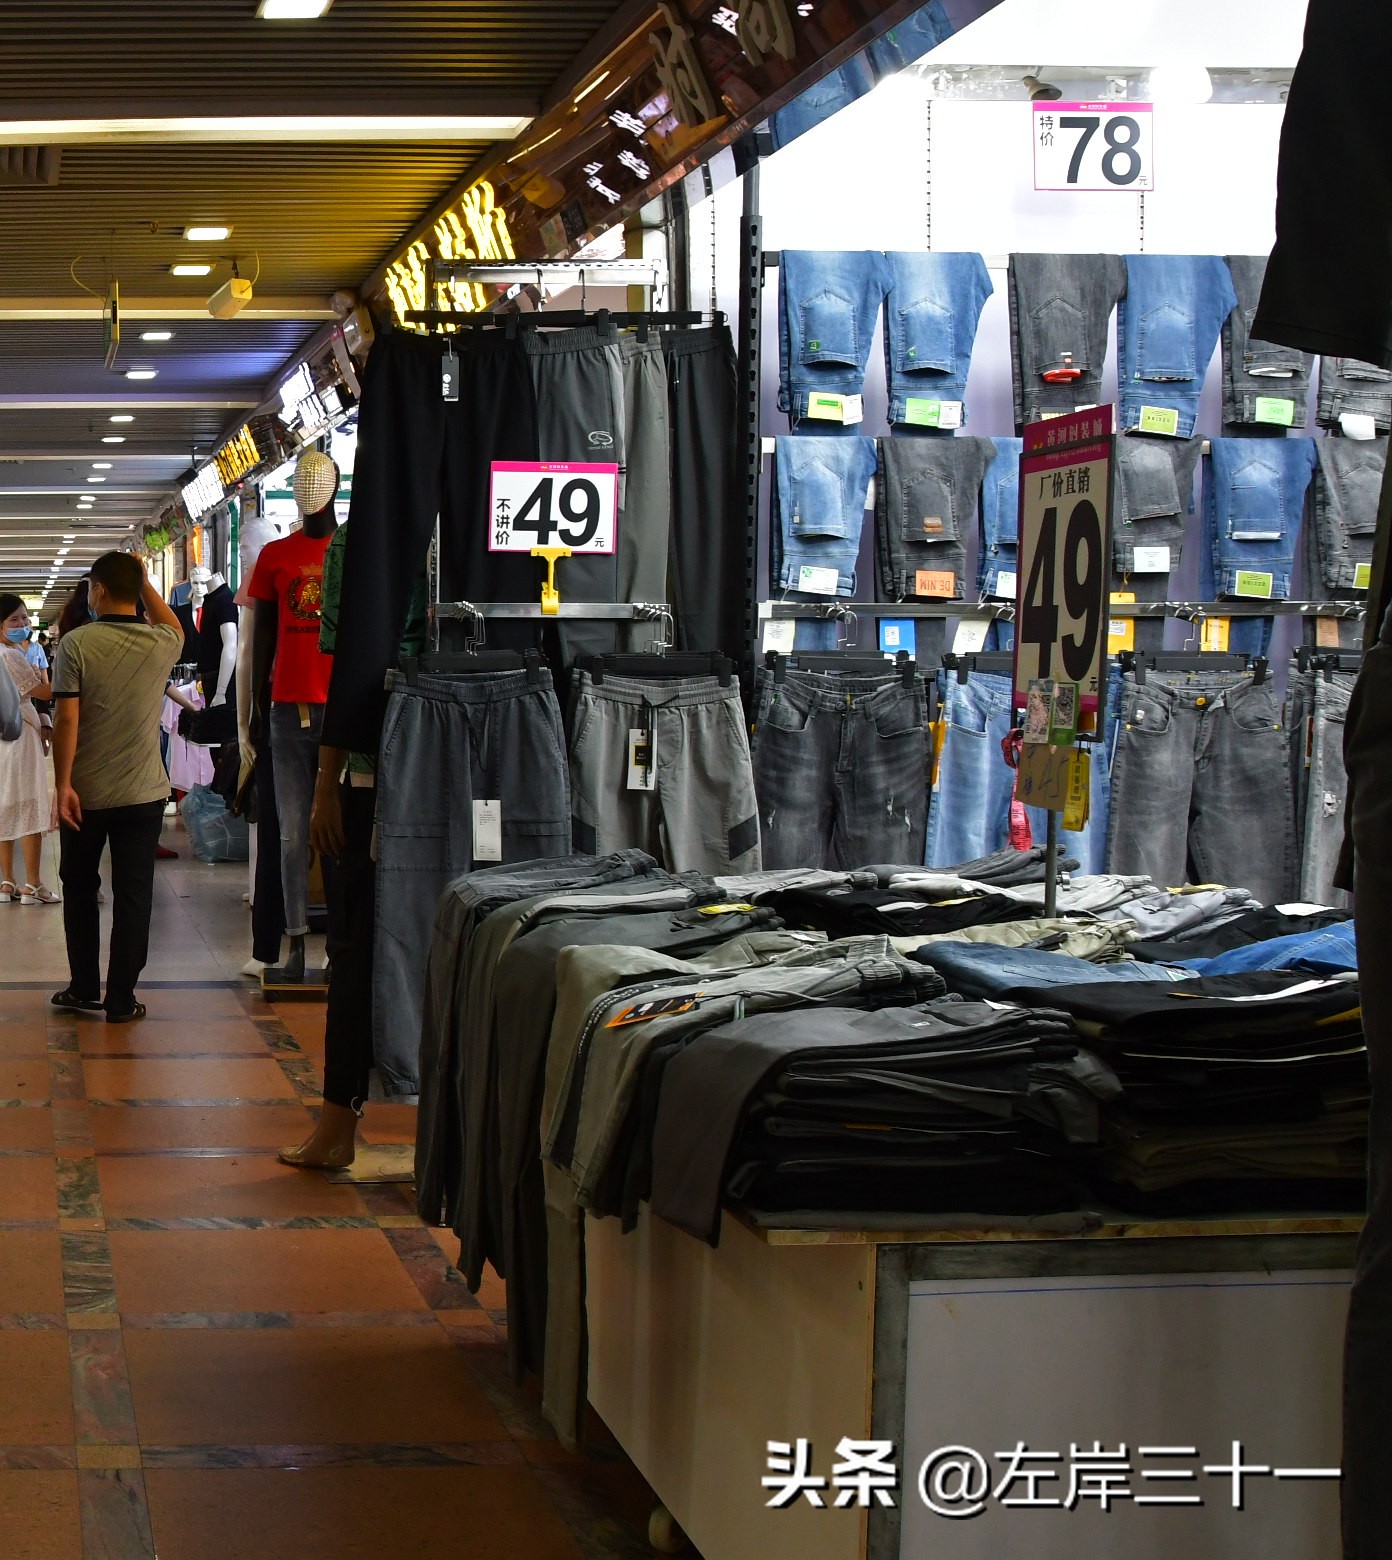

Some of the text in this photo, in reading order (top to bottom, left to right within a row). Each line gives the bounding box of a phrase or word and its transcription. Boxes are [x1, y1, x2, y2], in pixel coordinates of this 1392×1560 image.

[1039, 115, 1054, 147] 特价
[1059, 115, 1142, 186] 78
[1138, 175, 1148, 186] 元
[1039, 466, 1091, 500] 厂价直销
[495, 498, 511, 546] 不讲价
[512, 477, 601, 547] 49
[594, 537, 605, 548] 元
[1020, 498, 1104, 682] 49
[1088, 676, 1098, 692] 元
